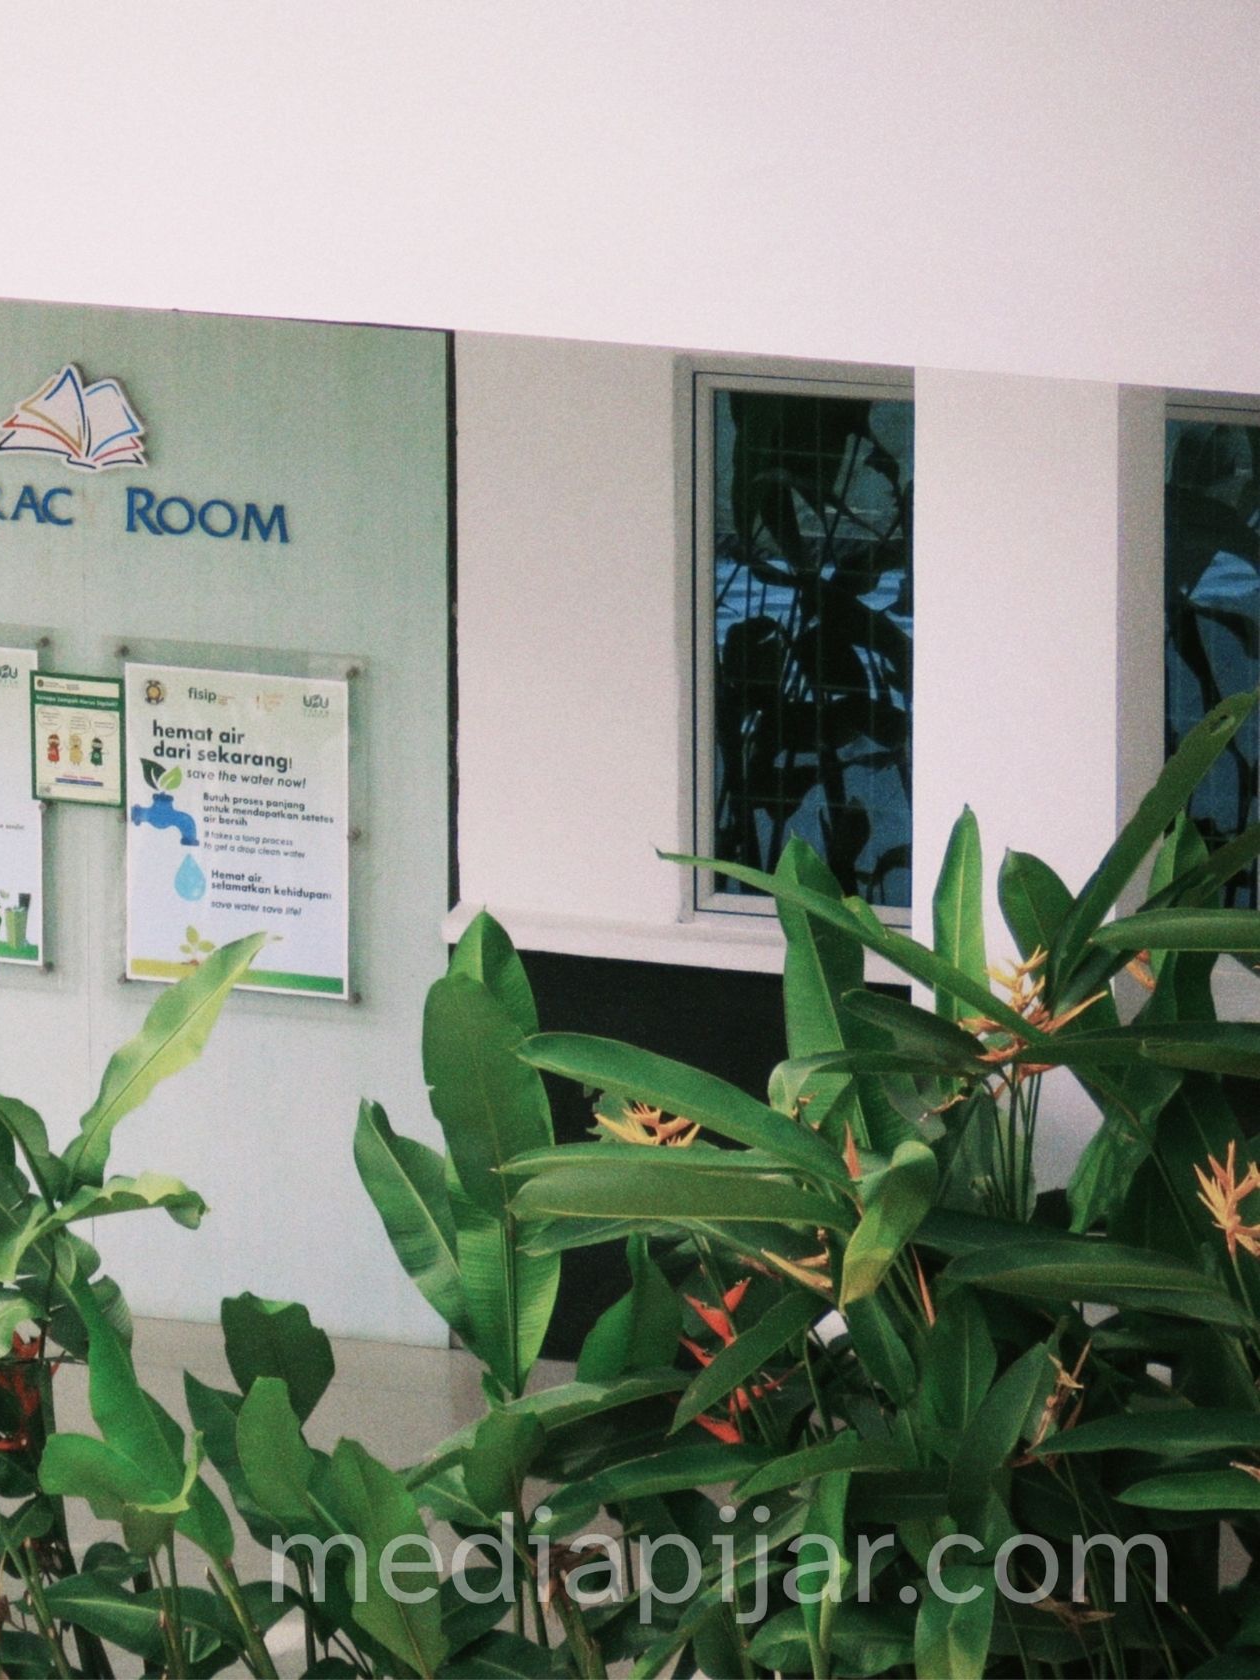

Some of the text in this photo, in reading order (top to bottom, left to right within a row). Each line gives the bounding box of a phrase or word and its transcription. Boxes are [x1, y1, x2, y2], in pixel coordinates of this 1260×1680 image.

[126, 486, 289, 544] ROOM
[188, 687, 217, 703] fisip
[153, 720, 245, 744] hemat air
[153, 741, 190, 760] dari
[187, 769, 306, 789] save the water now!
[233, 797, 263, 807] proses
[266, 800, 305, 812] panjang
[203, 805, 229, 814] untuk
[233, 807, 299, 821] mendapatkan
[219, 816, 248, 826] bersih
[211, 870, 245, 882] Hemat
[211, 881, 271, 895] selamatkan
[211, 901, 231, 909] save
[234, 903, 260, 912] water
[262, 905, 283, 914] save
